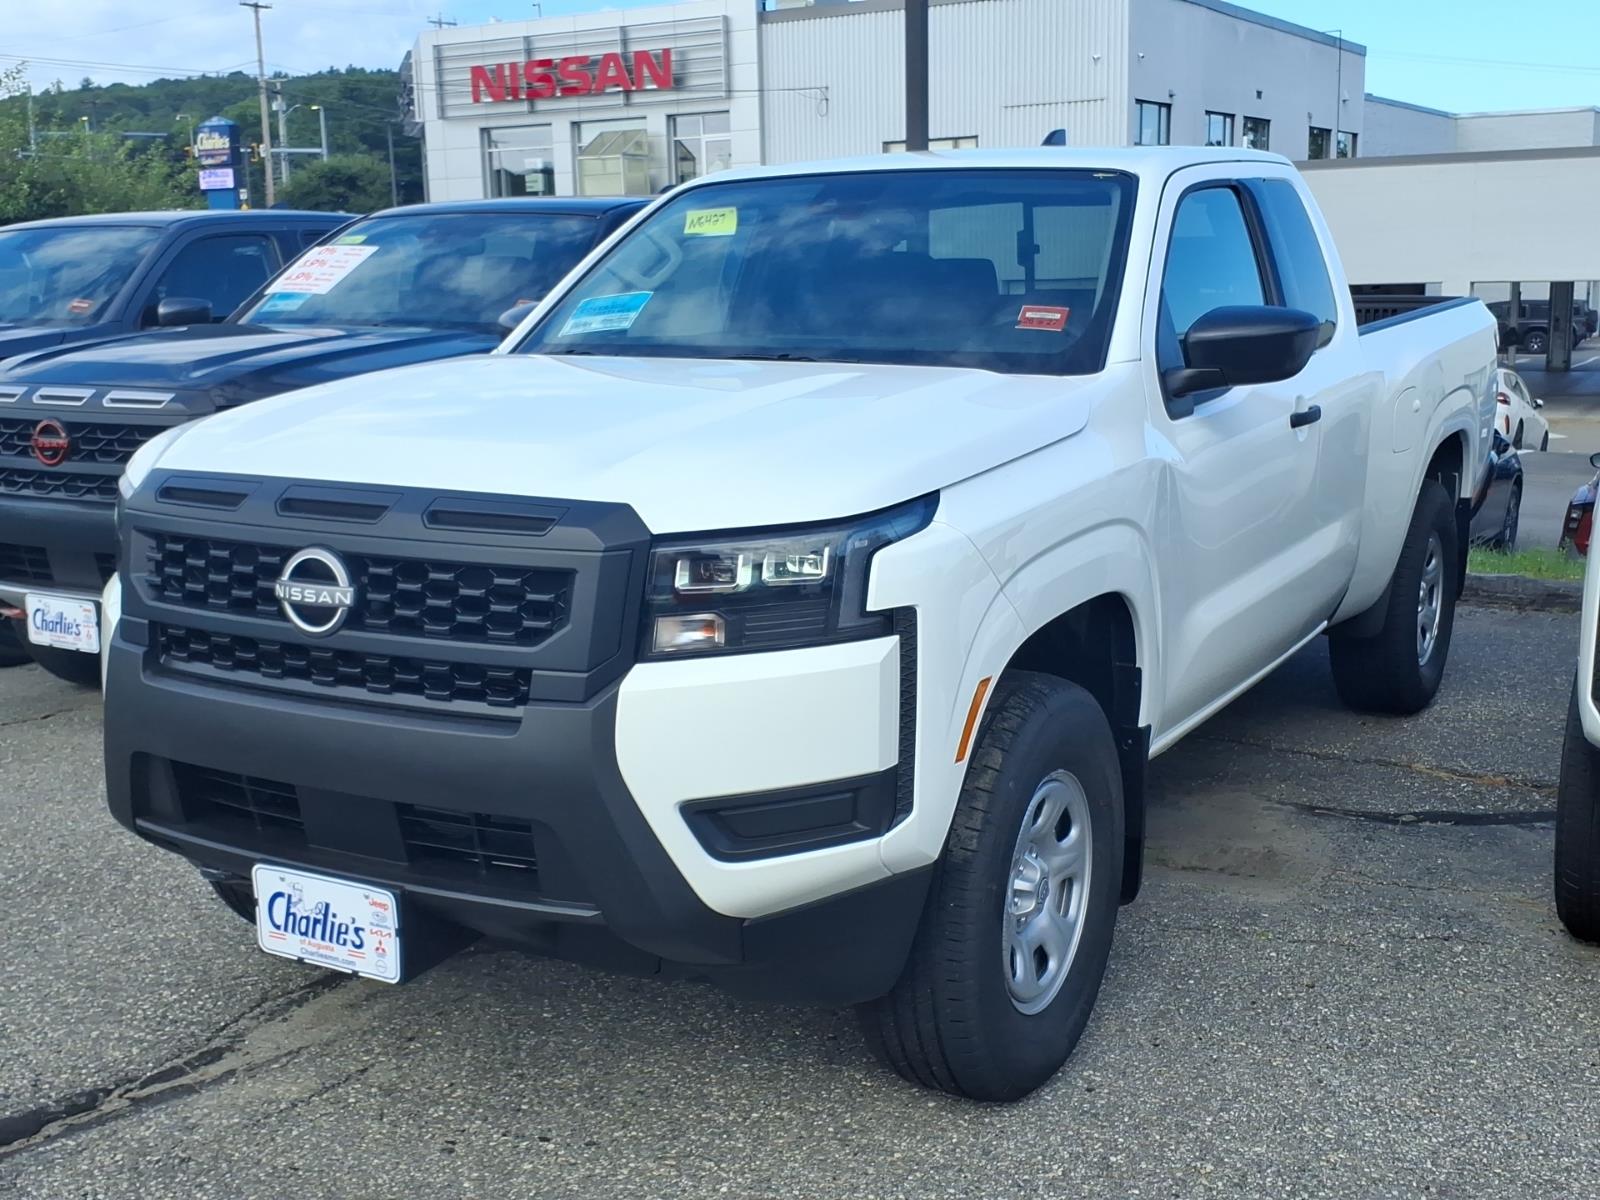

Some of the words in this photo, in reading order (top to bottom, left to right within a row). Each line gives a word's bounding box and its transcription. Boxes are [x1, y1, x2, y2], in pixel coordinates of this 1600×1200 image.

[469, 48, 673, 104] NISSAN
[275, 583, 351, 605] NISSAN
[33, 608, 82, 637] Charlie's
[368, 899, 390, 911] Jeep
[268, 891, 366, 950] Charlie's
